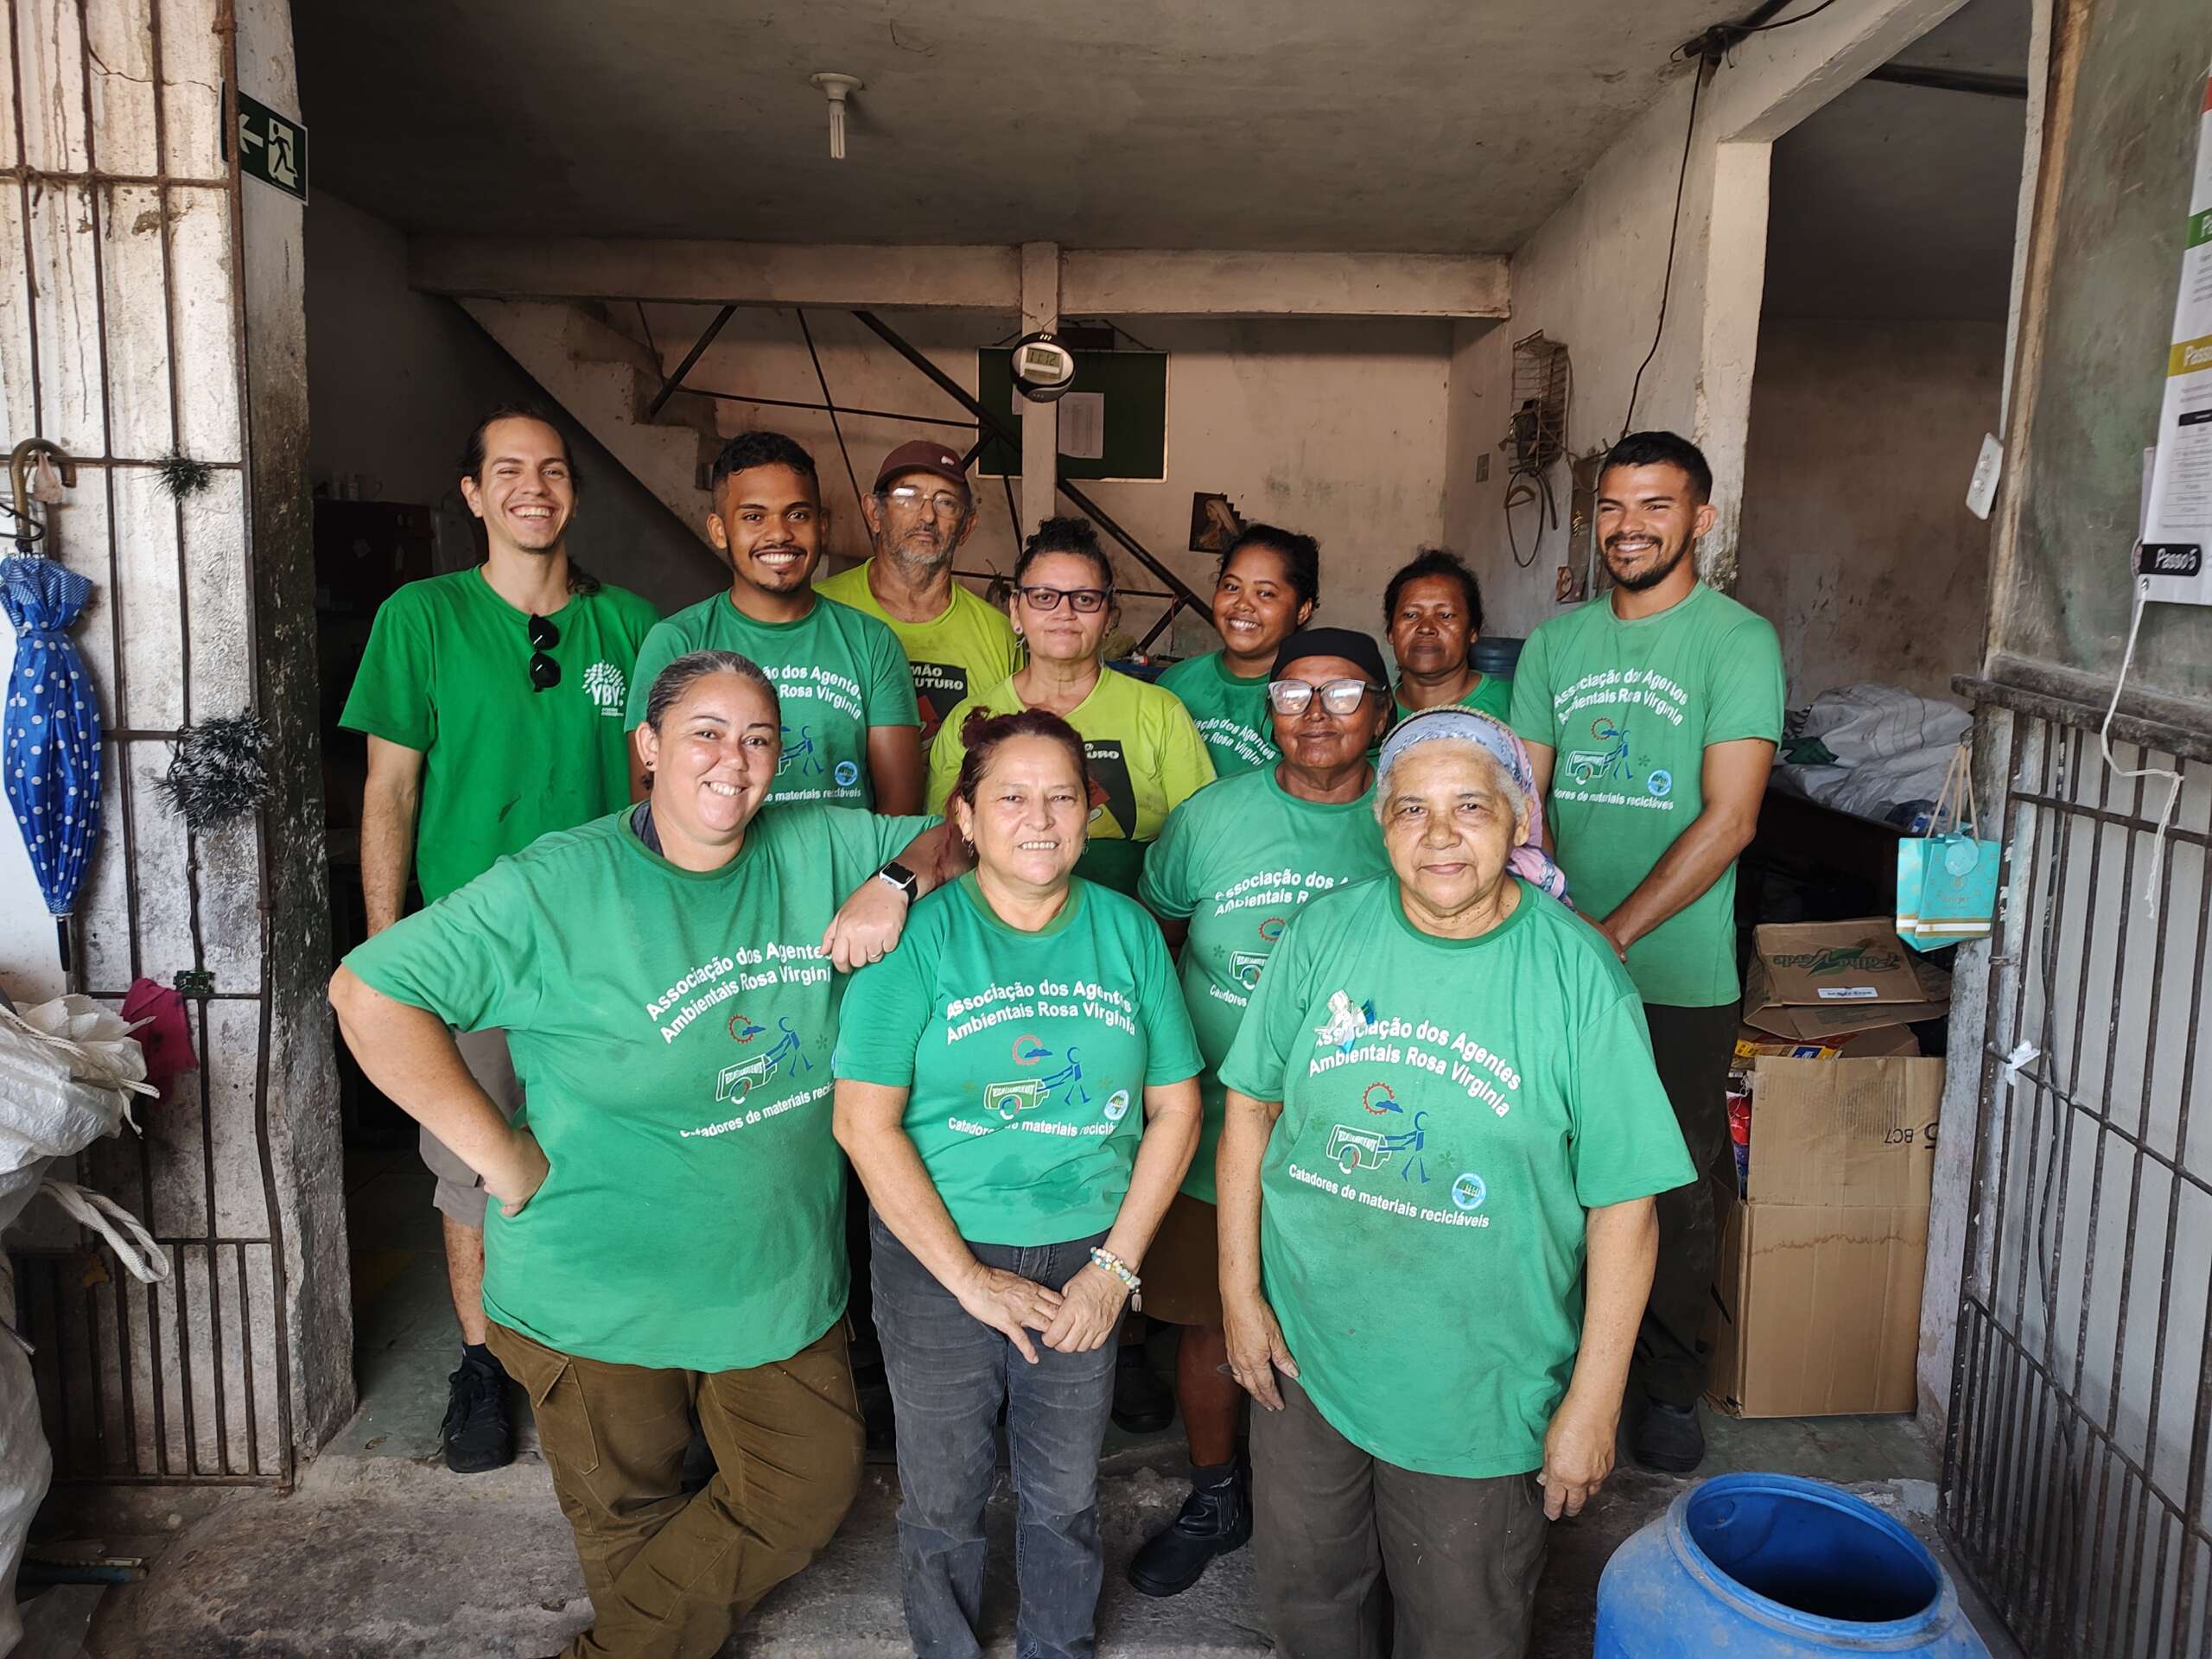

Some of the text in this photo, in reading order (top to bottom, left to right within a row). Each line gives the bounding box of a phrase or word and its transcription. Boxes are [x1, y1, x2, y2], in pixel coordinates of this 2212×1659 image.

[2154, 548, 2188, 569] Passo
[781, 664, 808, 679] dos
[912, 677, 964, 690] UTURO
[779, 683, 813, 698] Rosa
[1234, 741, 1265, 766] Virgini
[775, 787, 821, 802] materiais
[1305, 871, 1335, 890] dos
[645, 956, 734, 1022] Associação
[735, 947, 763, 966] dos
[660, 965, 831, 1045] Ambientais Rosa Virgini
[947, 982, 1035, 1020] Associação
[1039, 979, 1069, 996] dos
[947, 1001, 1135, 1046] Ambientais Rosa Virginia
[1314, 1016, 1522, 1090] Assciação dos Agentes
[1309, 1044, 1510, 1118] Ambientais Rosa Virginia
[746, 1110, 761, 1124] de
[762, 1091, 810, 1118] materiais
[1022, 1120, 1078, 1137] materiais
[1885, 1128, 1914, 1144] BC7
[1288, 1163, 1490, 1228] Catadores de materiais recicláveis
